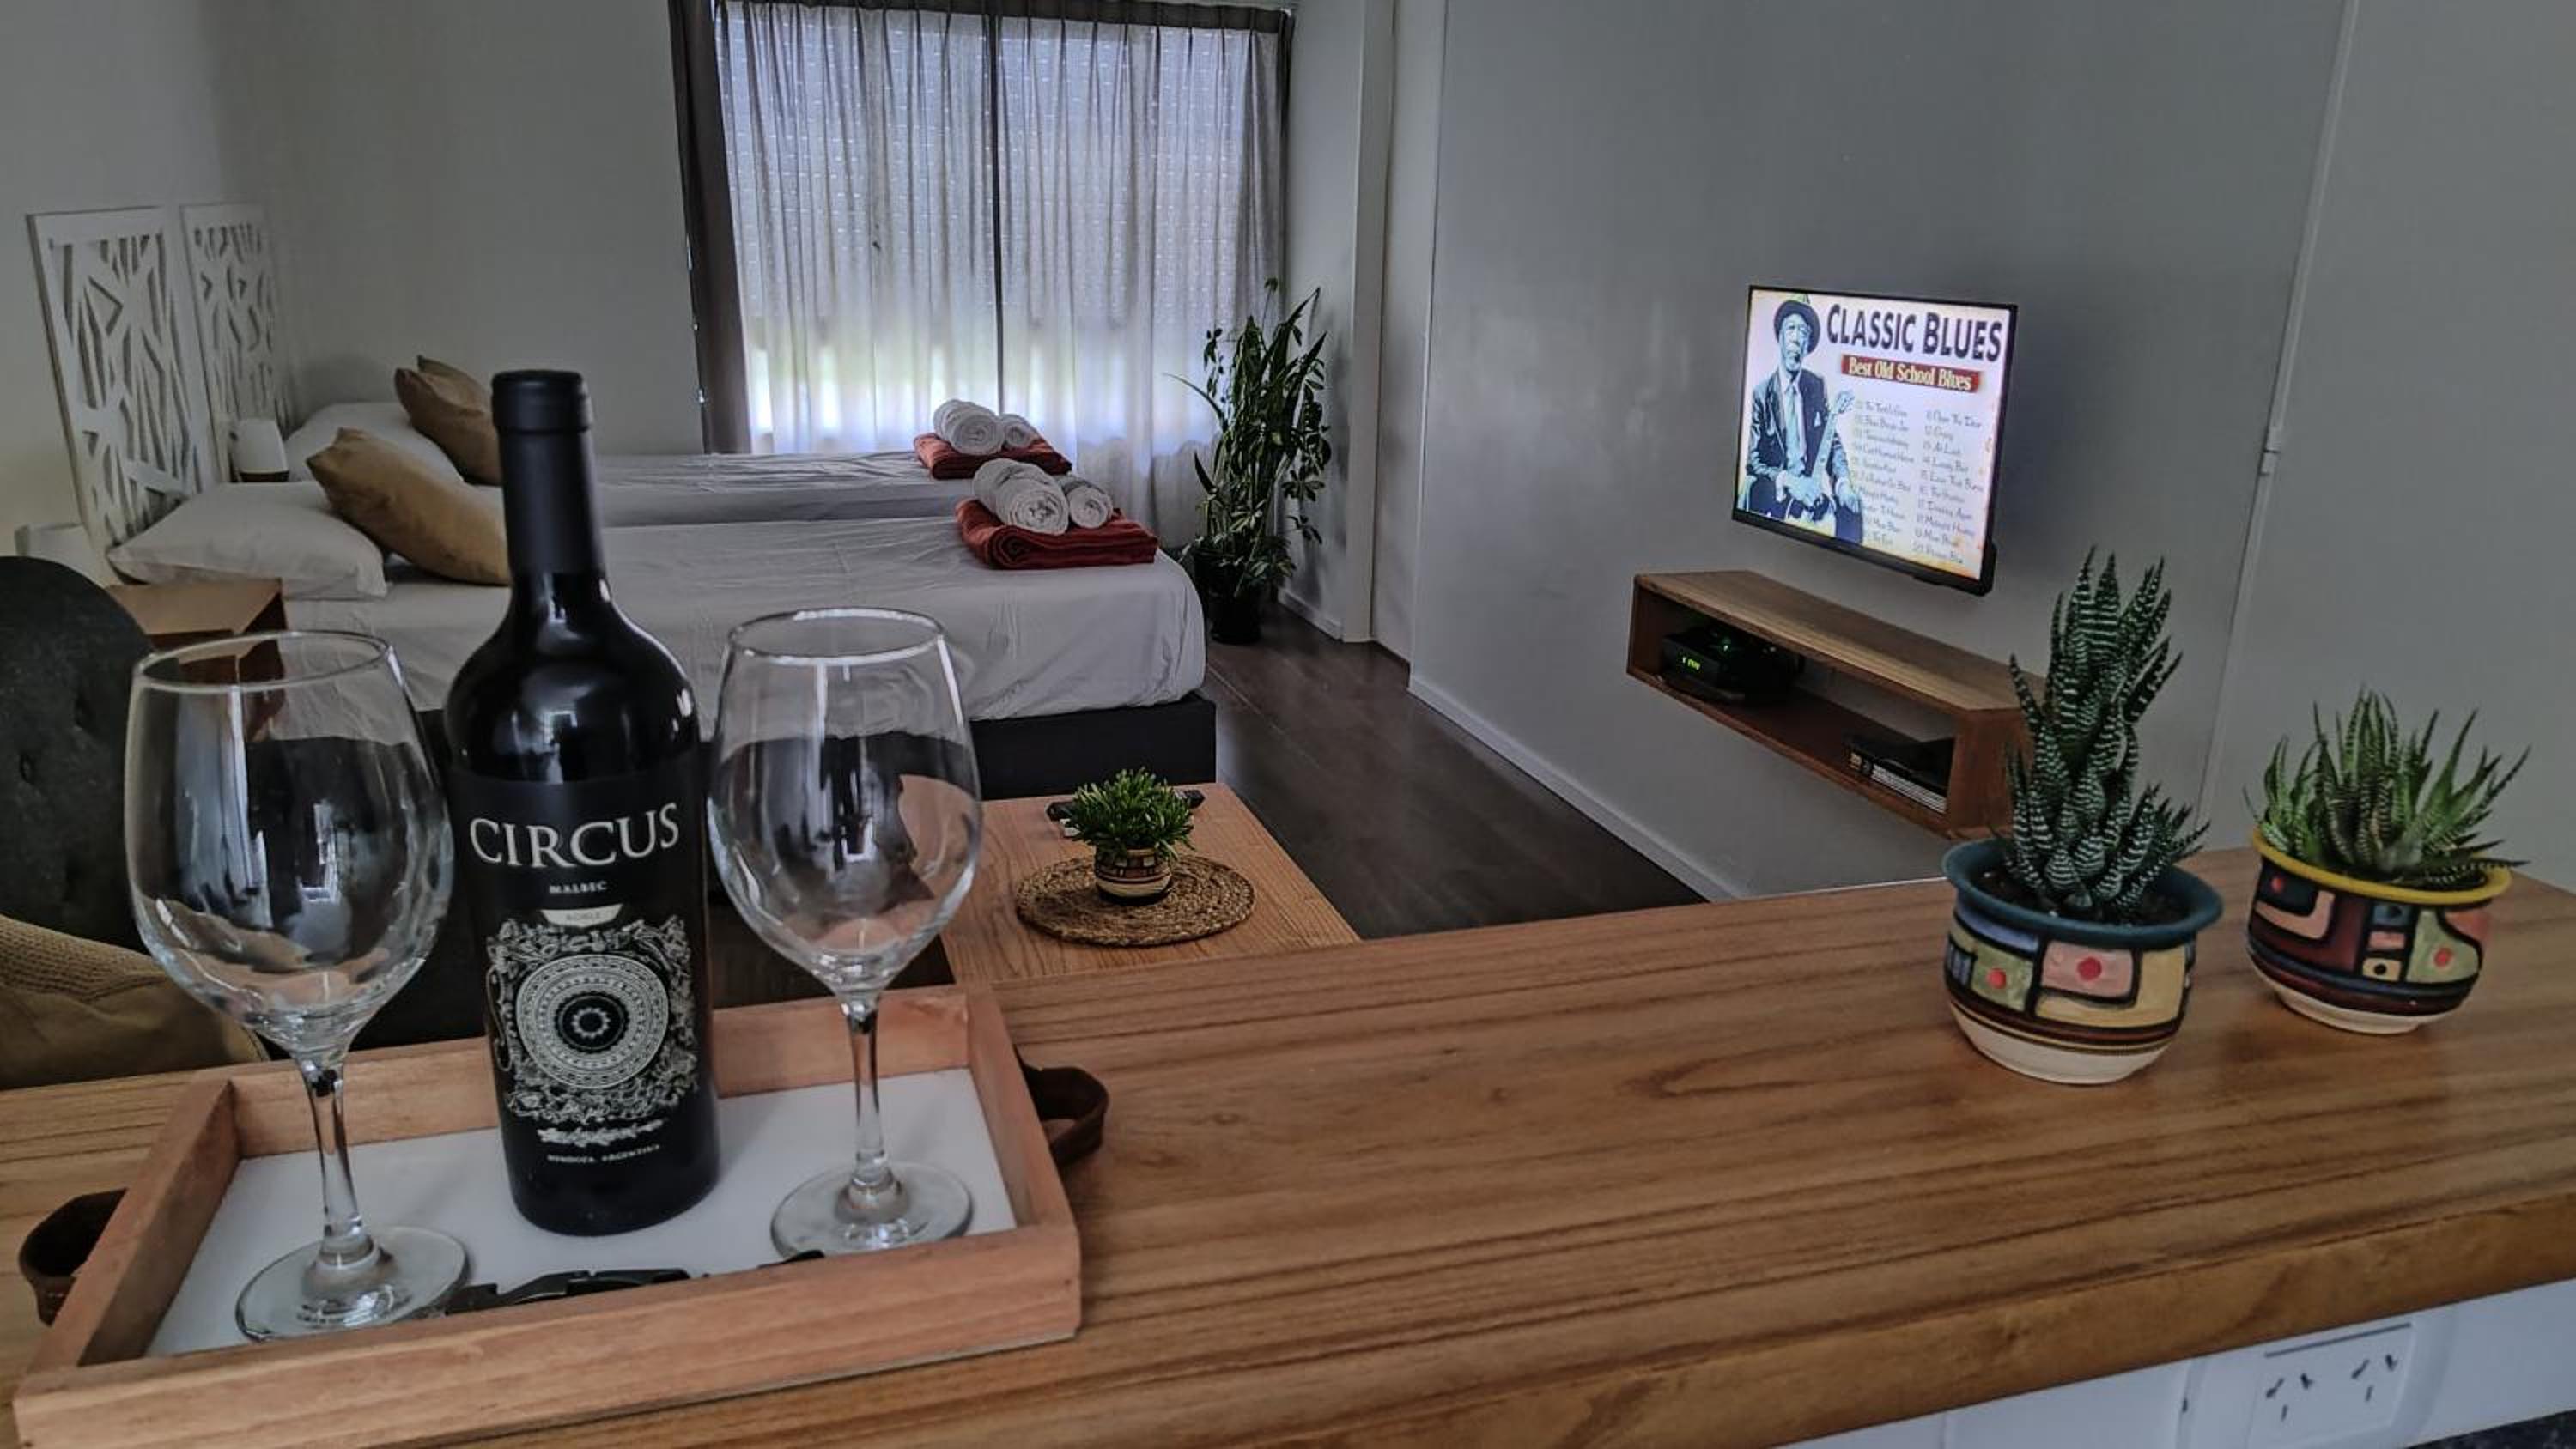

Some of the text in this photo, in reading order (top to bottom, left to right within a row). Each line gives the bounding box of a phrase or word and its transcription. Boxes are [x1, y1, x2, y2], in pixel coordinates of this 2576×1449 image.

[1827, 304, 2002, 362] CLASSIC BLUES
[1849, 356, 1972, 391] Best Old School Blues
[470, 802, 680, 868] CIRCUS
[549, 880, 608, 894] MALBEC
